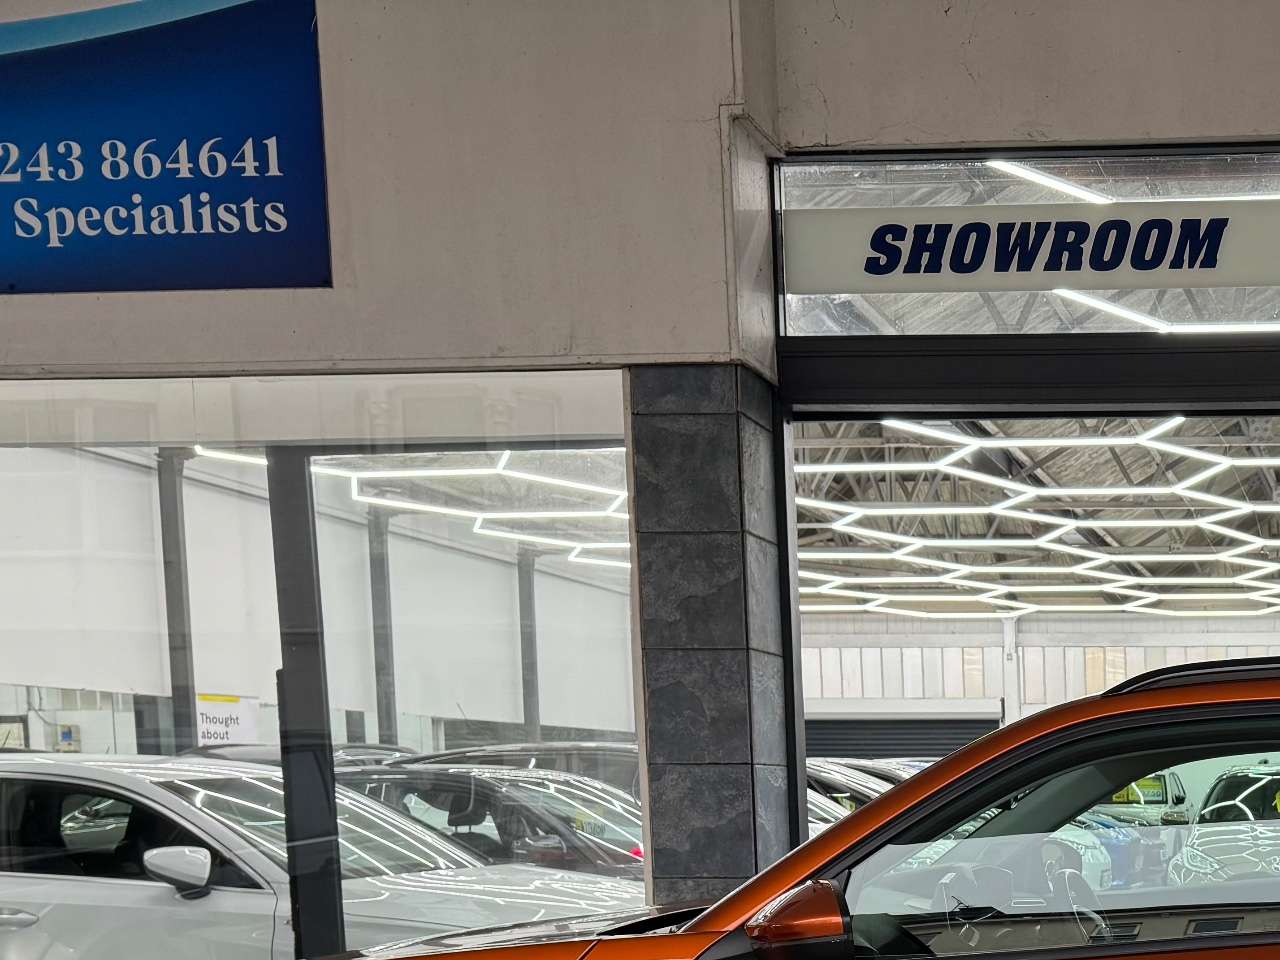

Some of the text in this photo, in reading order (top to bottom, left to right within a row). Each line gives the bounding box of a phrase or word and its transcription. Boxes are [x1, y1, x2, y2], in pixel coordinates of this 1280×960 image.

[0, 136, 284, 183] 243 864641
[14, 191, 288, 248] Specialists
[863, 217, 1230, 276] SHOWROOM
[200, 712, 240, 727] Thought
[201, 729, 230, 740] about
